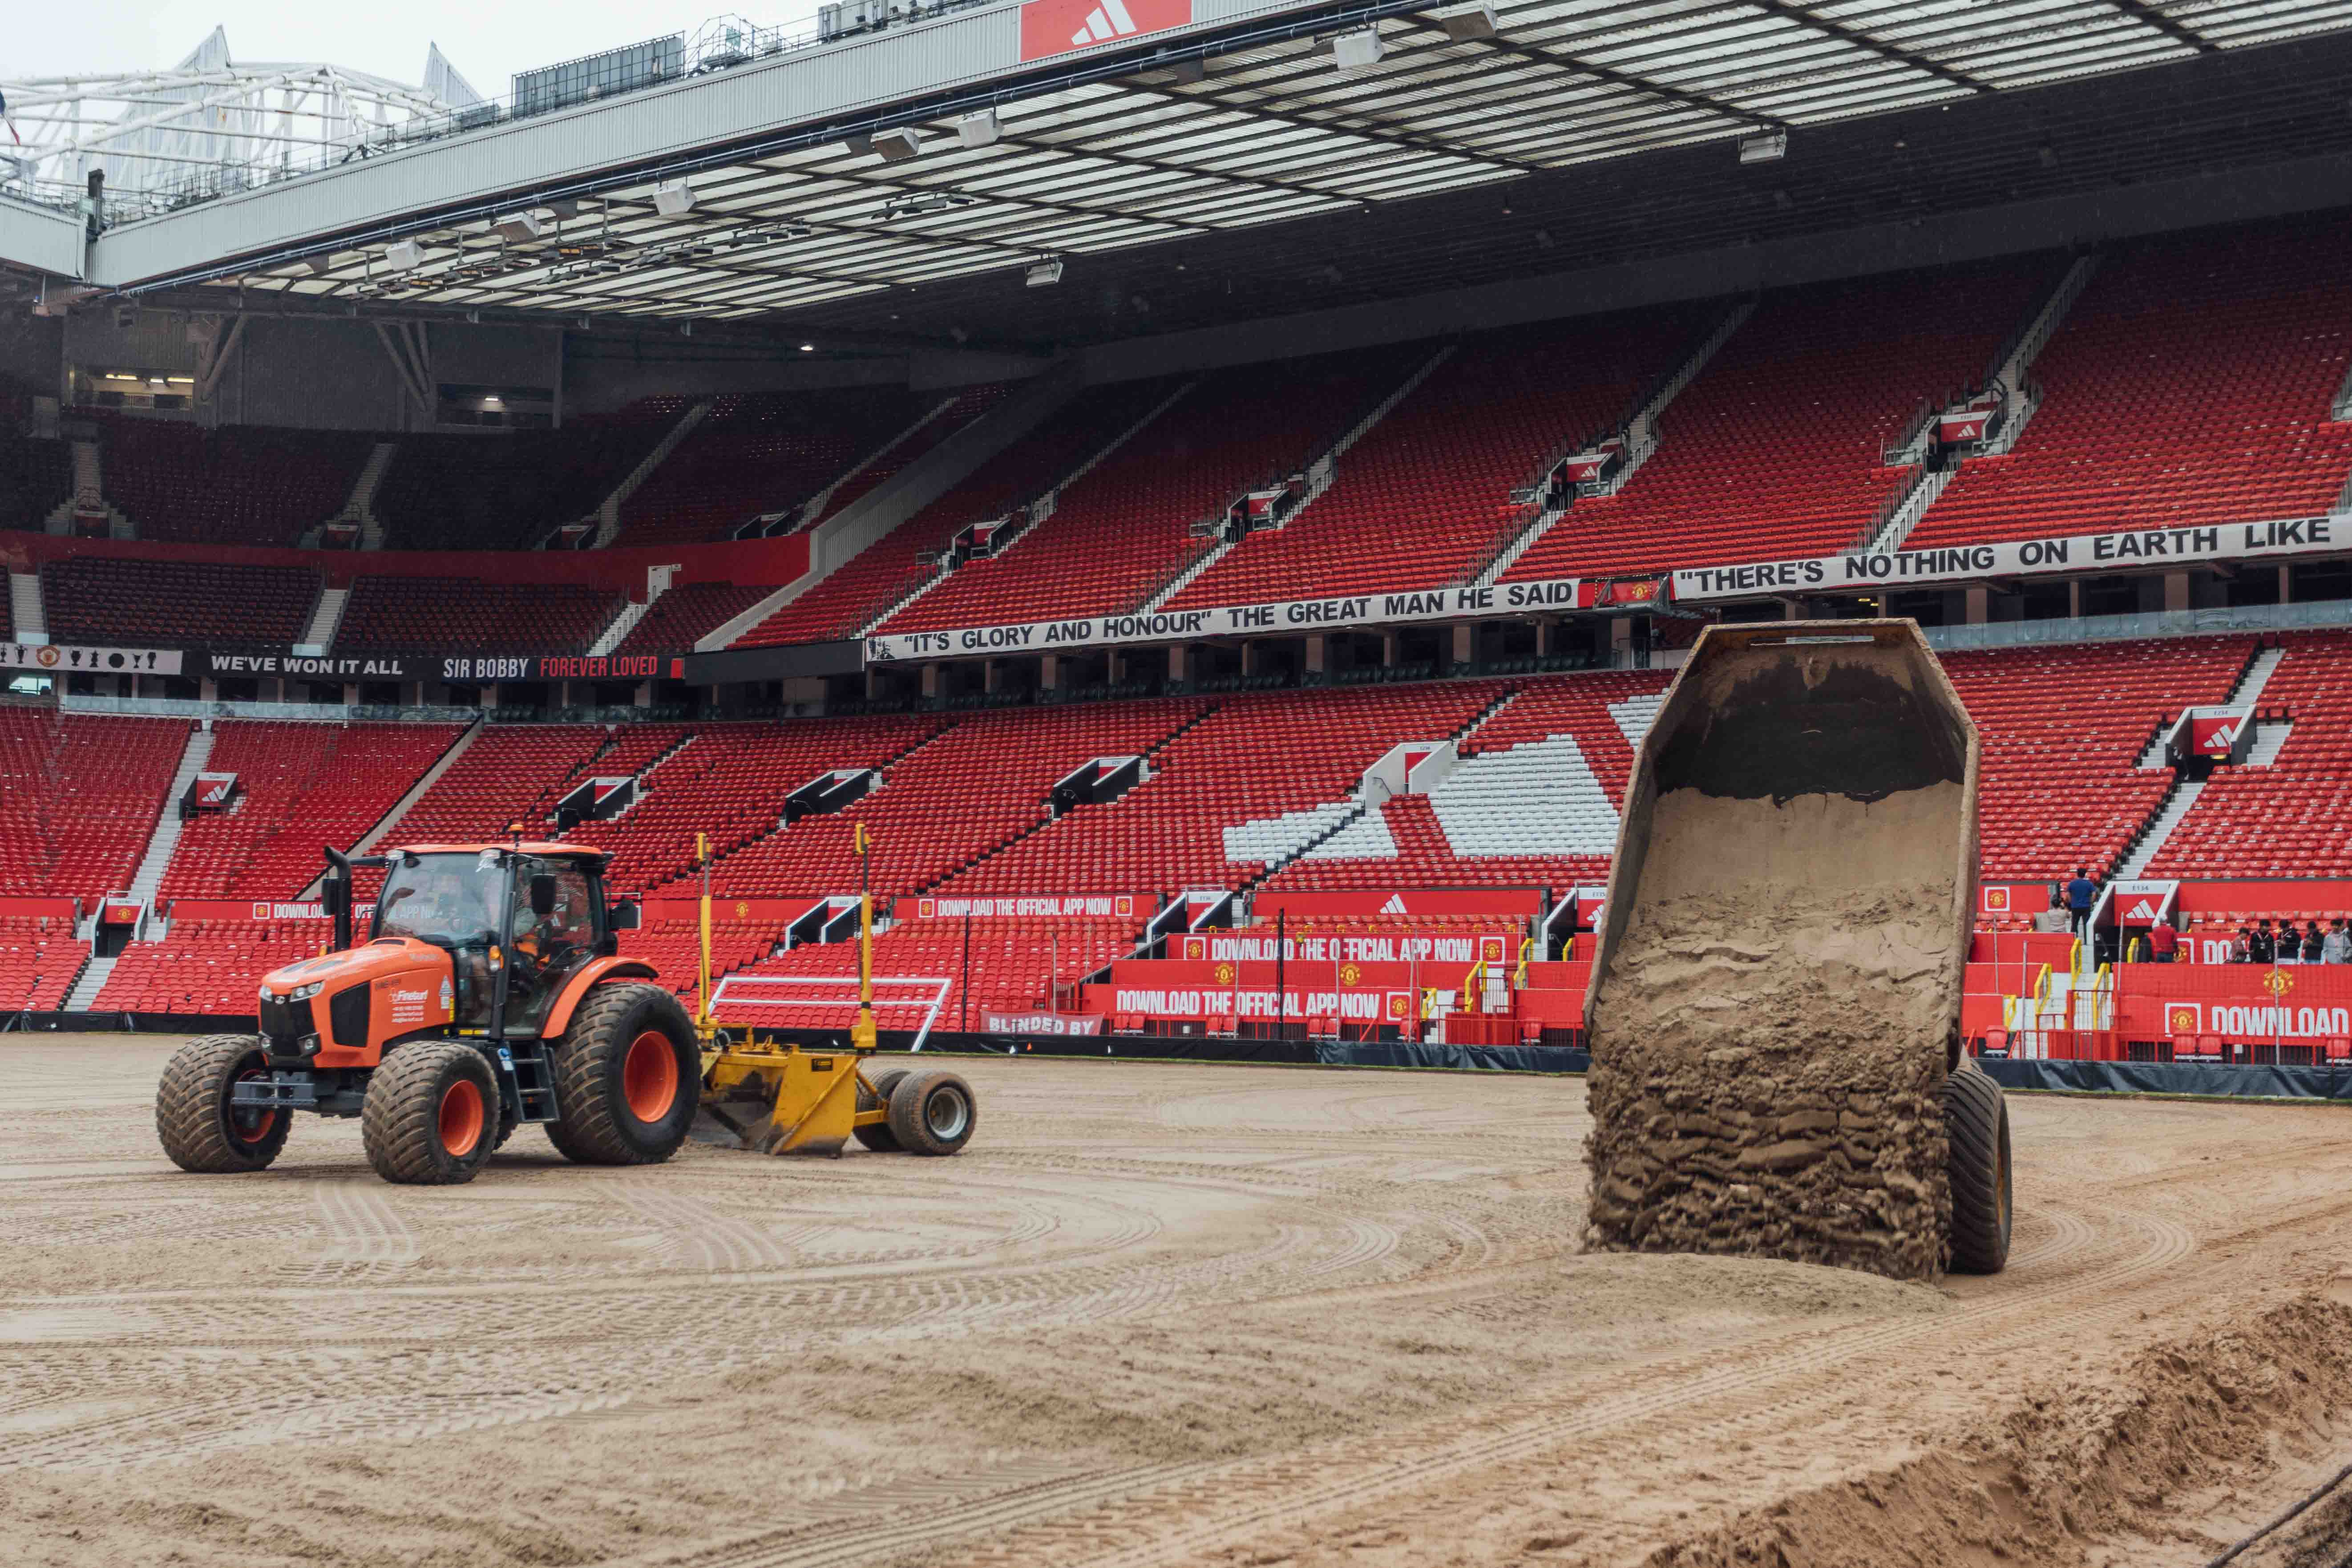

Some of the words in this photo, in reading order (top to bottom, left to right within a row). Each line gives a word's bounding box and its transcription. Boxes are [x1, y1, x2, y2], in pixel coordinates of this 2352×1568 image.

[1680, 560, 1824, 592] "THERE'S
[1846, 547, 1995, 578] NOTHING
[2019, 540, 2068, 566] ON
[2093, 528, 2217, 561] EARTH
[2245, 518, 2331, 549] LIKE
[904, 632, 950, 653] "IT'S
[962, 626, 1034, 648] GLORY
[1045, 621, 1091, 643] AND
[1103, 611, 1212, 638] HONOUR"
[1228, 606, 1275, 628] THE
[1287, 597, 1371, 623] GREAT
[1385, 591, 1445, 616] MAN
[1458, 587, 1494, 609] HE
[1508, 582, 1572, 606] SAID
[211, 655, 277, 671] WE'VE
[283, 658, 333, 674] WON
[339, 659, 359, 674] IT
[363, 660, 403, 675] ALL
[443, 658, 470, 678] SIR
[476, 658, 529, 678] BOBBY
[540, 656, 607, 677] FOREVER
[612, 655, 658, 676] LOVED
[274, 904, 331, 918] DOWNLOA
[938, 899, 994, 916] DOWNLOAD
[995, 899, 1015, 916] THE
[1017, 898, 1062, 915] OFFICIAL
[1063, 898, 1084, 915] APP
[1086, 898, 1111, 915] NOW
[1400, 938, 1431, 961] APP
[1434, 938, 1473, 961] NOW
[1117, 990, 1200, 1014] DOWNLOAD
[1202, 991, 1232, 1015] THE
[1305, 993, 1338, 1016] APP
[1341, 993, 1379, 1018] NOW
[989, 1017, 1064, 1033] BLINDED
[1069, 1021, 1094, 1035] BY
[2212, 1006, 2349, 1037] DOWNLOAD
